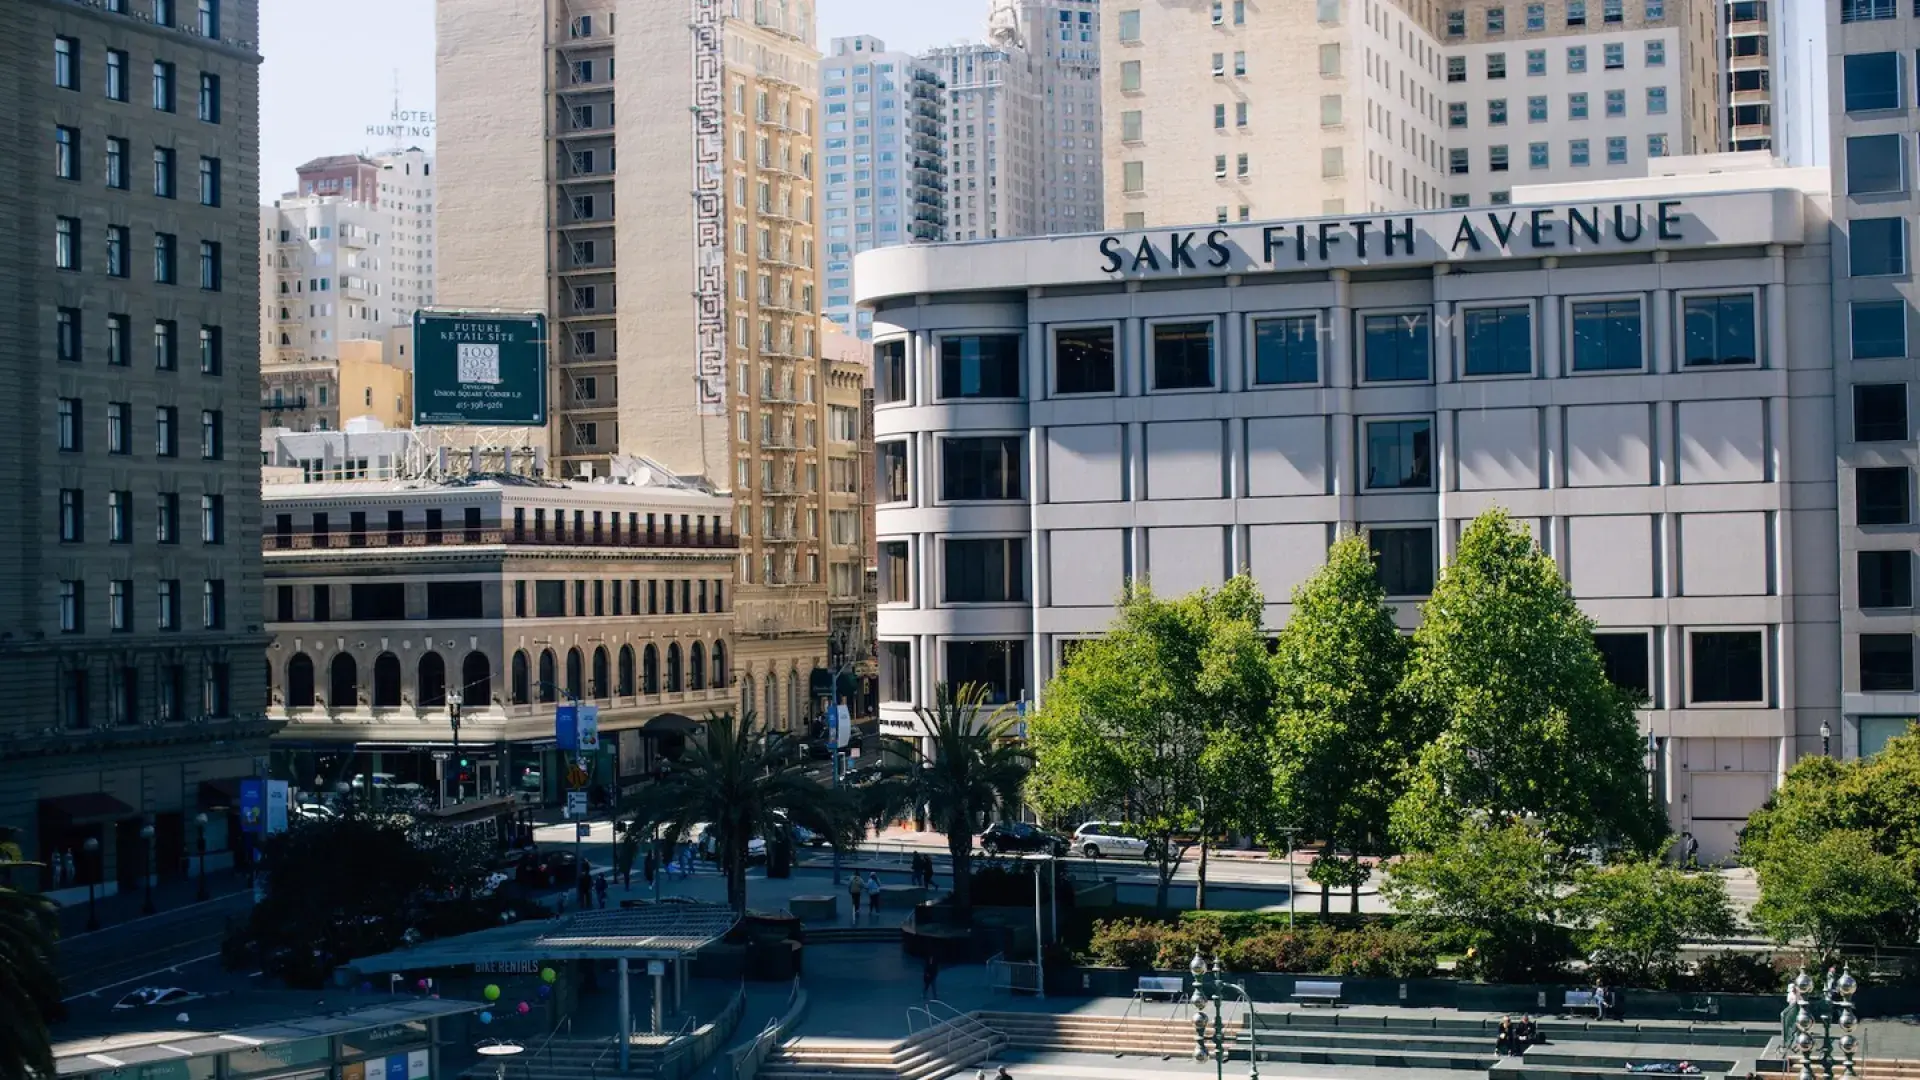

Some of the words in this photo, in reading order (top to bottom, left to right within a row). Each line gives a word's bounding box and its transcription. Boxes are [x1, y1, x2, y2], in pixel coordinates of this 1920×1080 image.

[391, 111, 435, 122] HOTEL
[366, 125, 436, 137] HUNTING
[1100, 230, 1230, 272] SAKS
[1264, 218, 1414, 263] FIFTH
[1452, 201, 1683, 252] AVENUE
[454, 323, 501, 332] FUTURE
[440, 331, 484, 341] RETAIL
[488, 332, 514, 341] SITE
[699, 265, 721, 403] HOTEL
[462, 347, 494, 358] 400
[462, 358, 494, 368] POST
[462, 368, 496, 378] STREET
[499, 960, 539, 973] RENTALS
